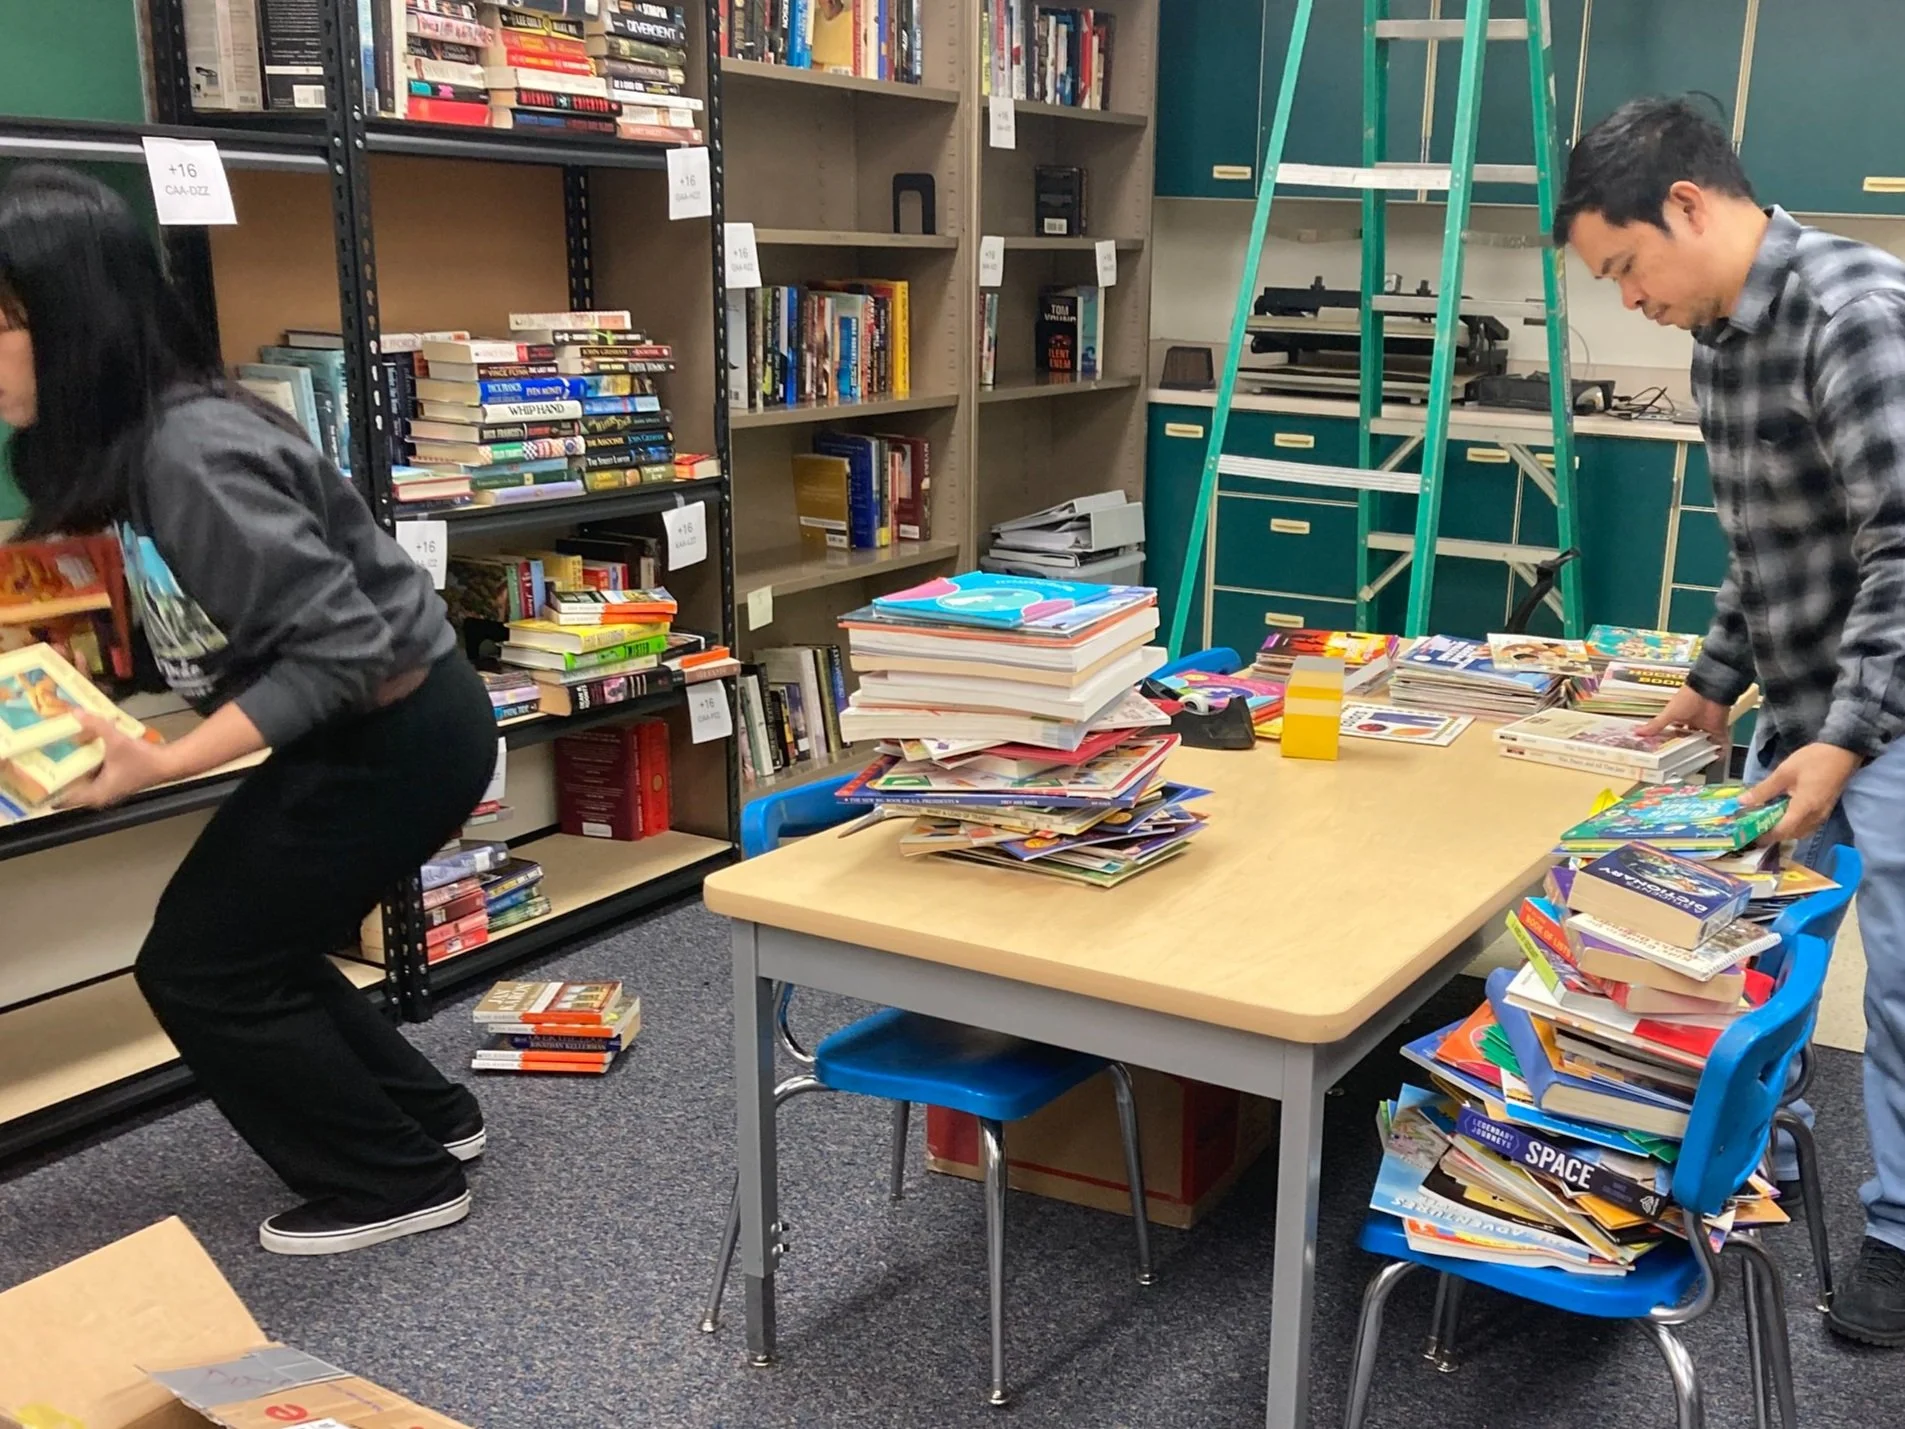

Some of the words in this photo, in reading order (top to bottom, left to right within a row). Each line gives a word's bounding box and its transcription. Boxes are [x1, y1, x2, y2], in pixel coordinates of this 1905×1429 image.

[626, 19, 677, 40] DIVERGENT
[169, 163, 197, 178] +16
[680, 174, 696, 187] +16
[165, 185, 211, 196] CAA-DZZ
[733, 247, 749, 258] +16
[508, 405, 539, 417] WHIP
[538, 404, 565, 416] HAND
[678, 522, 694, 534] +16
[416, 540, 436, 553] +16
[624, 641, 650, 659] TWISTED
[700, 698, 715, 709] +16
[1598, 867, 1709, 912] DICTIONARY
[1472, 1118, 1515, 1140] LEGENDARY
[1470, 1127, 1512, 1149] JOURNEYS
[1525, 1141, 1595, 1189] SPACE
[1391, 1197, 1526, 1238] ADVENTURES
